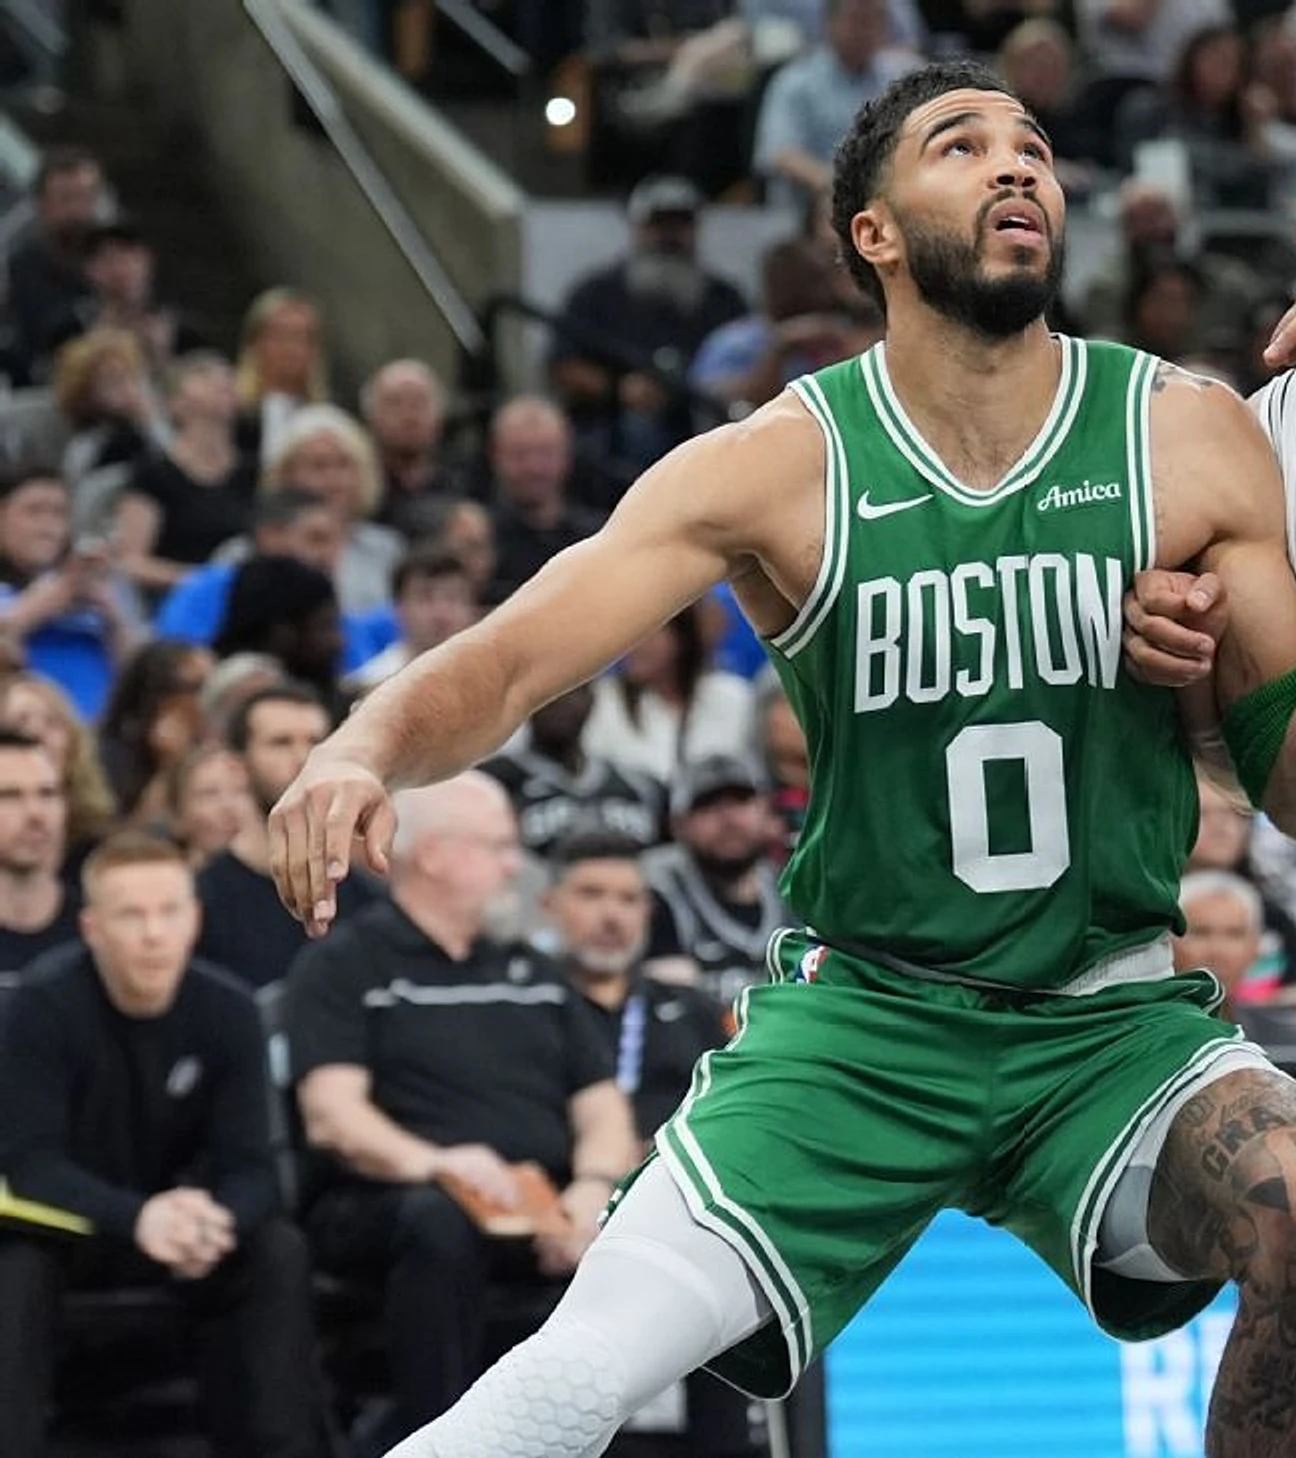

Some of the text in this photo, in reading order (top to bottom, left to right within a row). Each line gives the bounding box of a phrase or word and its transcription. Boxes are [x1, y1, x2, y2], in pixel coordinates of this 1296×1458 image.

[1037, 480, 1122, 511] Amica
[854, 551, 1122, 713] BOSTON
[946, 720, 1071, 893] 0
